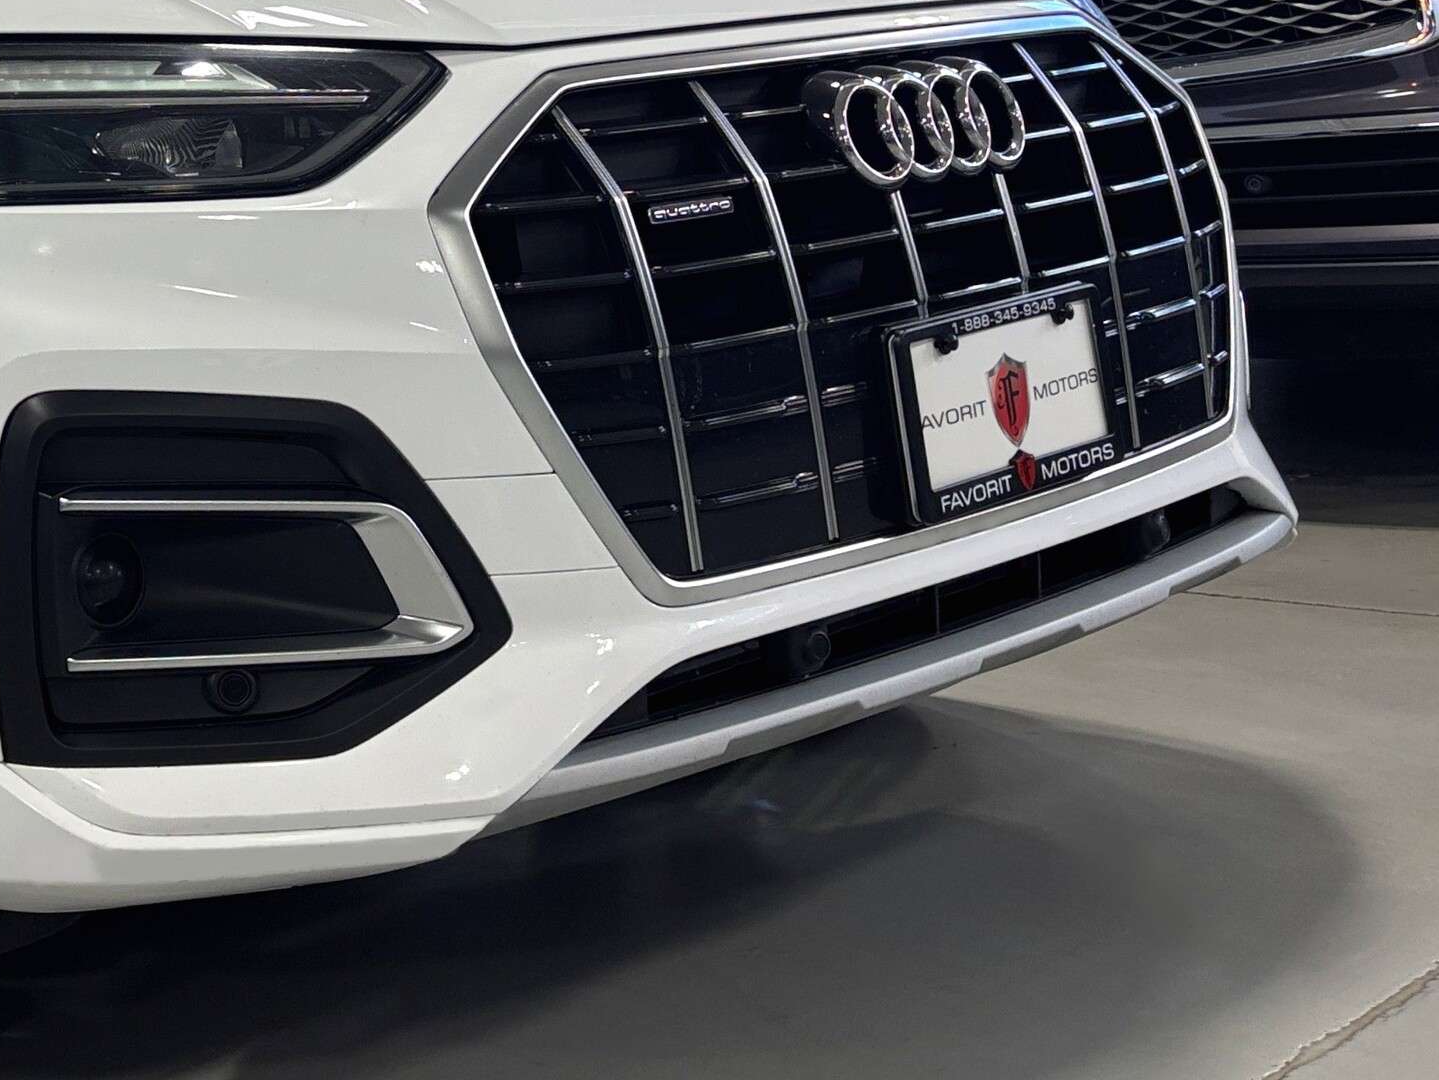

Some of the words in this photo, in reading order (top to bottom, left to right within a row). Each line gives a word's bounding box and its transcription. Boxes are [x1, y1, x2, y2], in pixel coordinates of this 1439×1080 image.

[654, 200, 730, 219] quattro
[952, 297, 1057, 334] 1-888-345-9345
[1033, 368, 1099, 400] MOTORS
[940, 474, 1012, 513] FAVORIT
[1041, 443, 1115, 481] MOTORS
